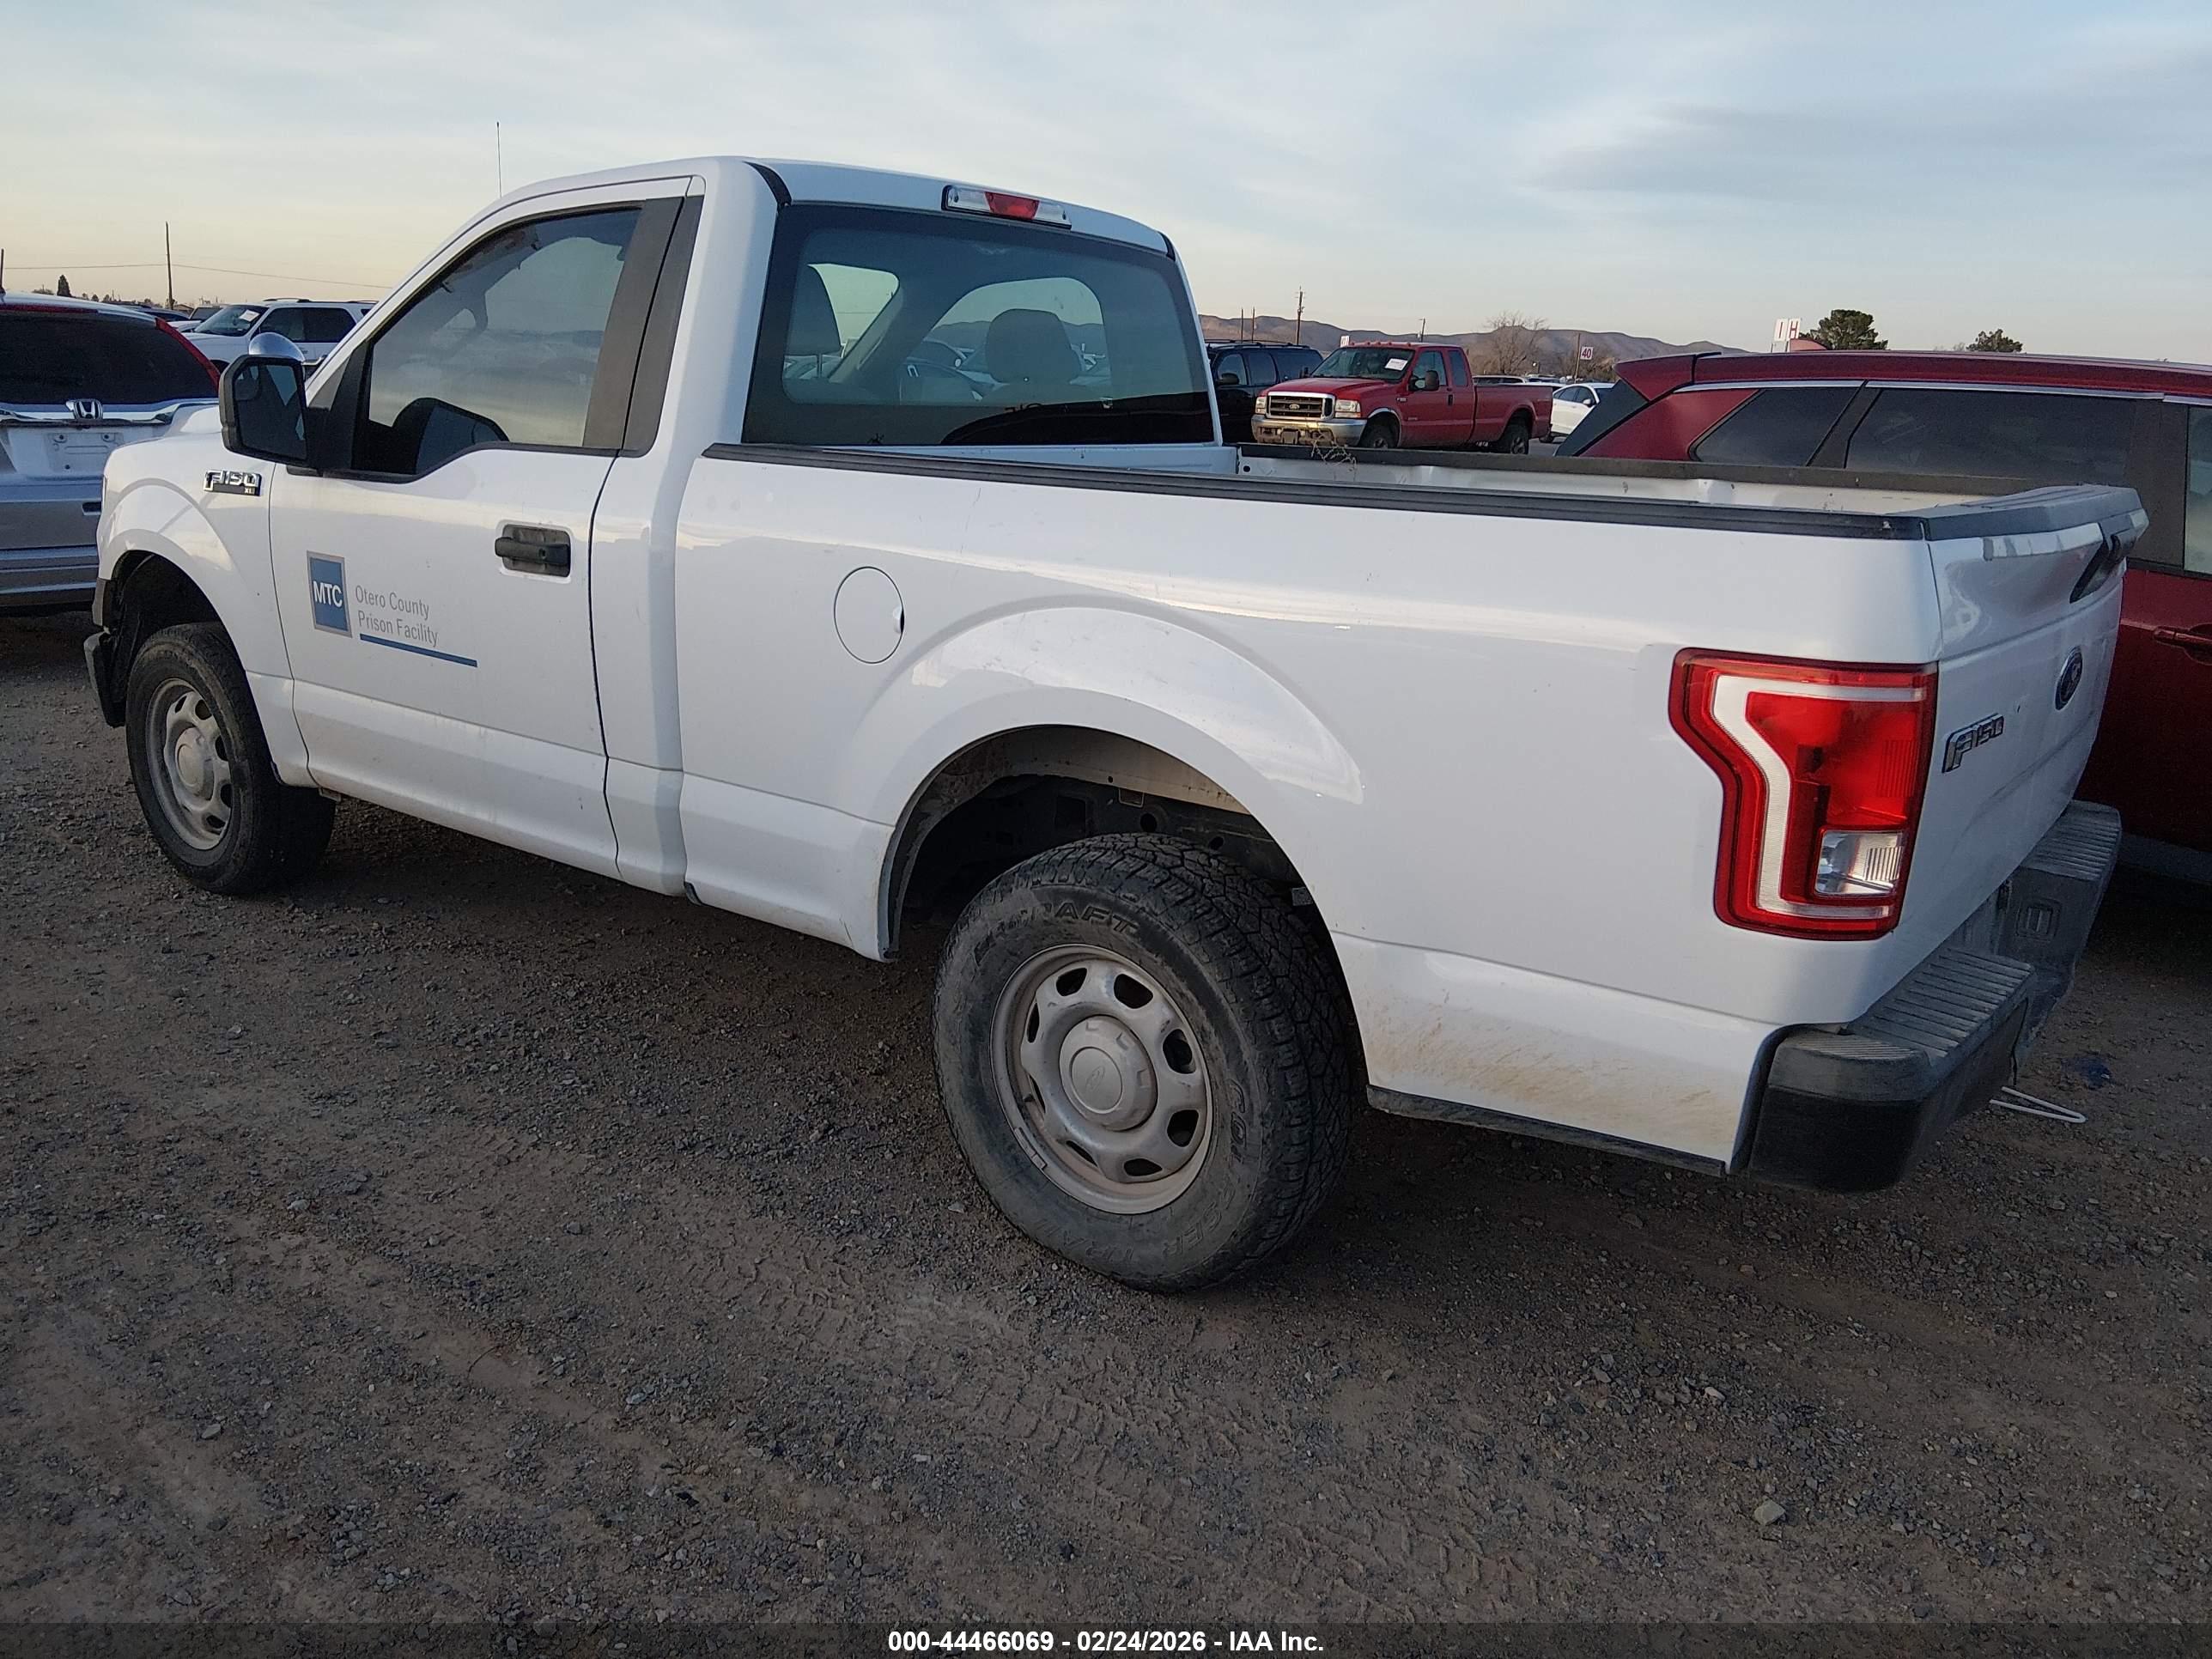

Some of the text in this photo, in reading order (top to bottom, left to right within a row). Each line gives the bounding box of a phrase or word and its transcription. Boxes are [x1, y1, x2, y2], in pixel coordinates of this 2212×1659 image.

[1582, 348, 1592, 359] 40
[313, 580, 343, 608] MTC
[355, 585, 429, 621] Otero County
[357, 610, 439, 647] Prison Facility
